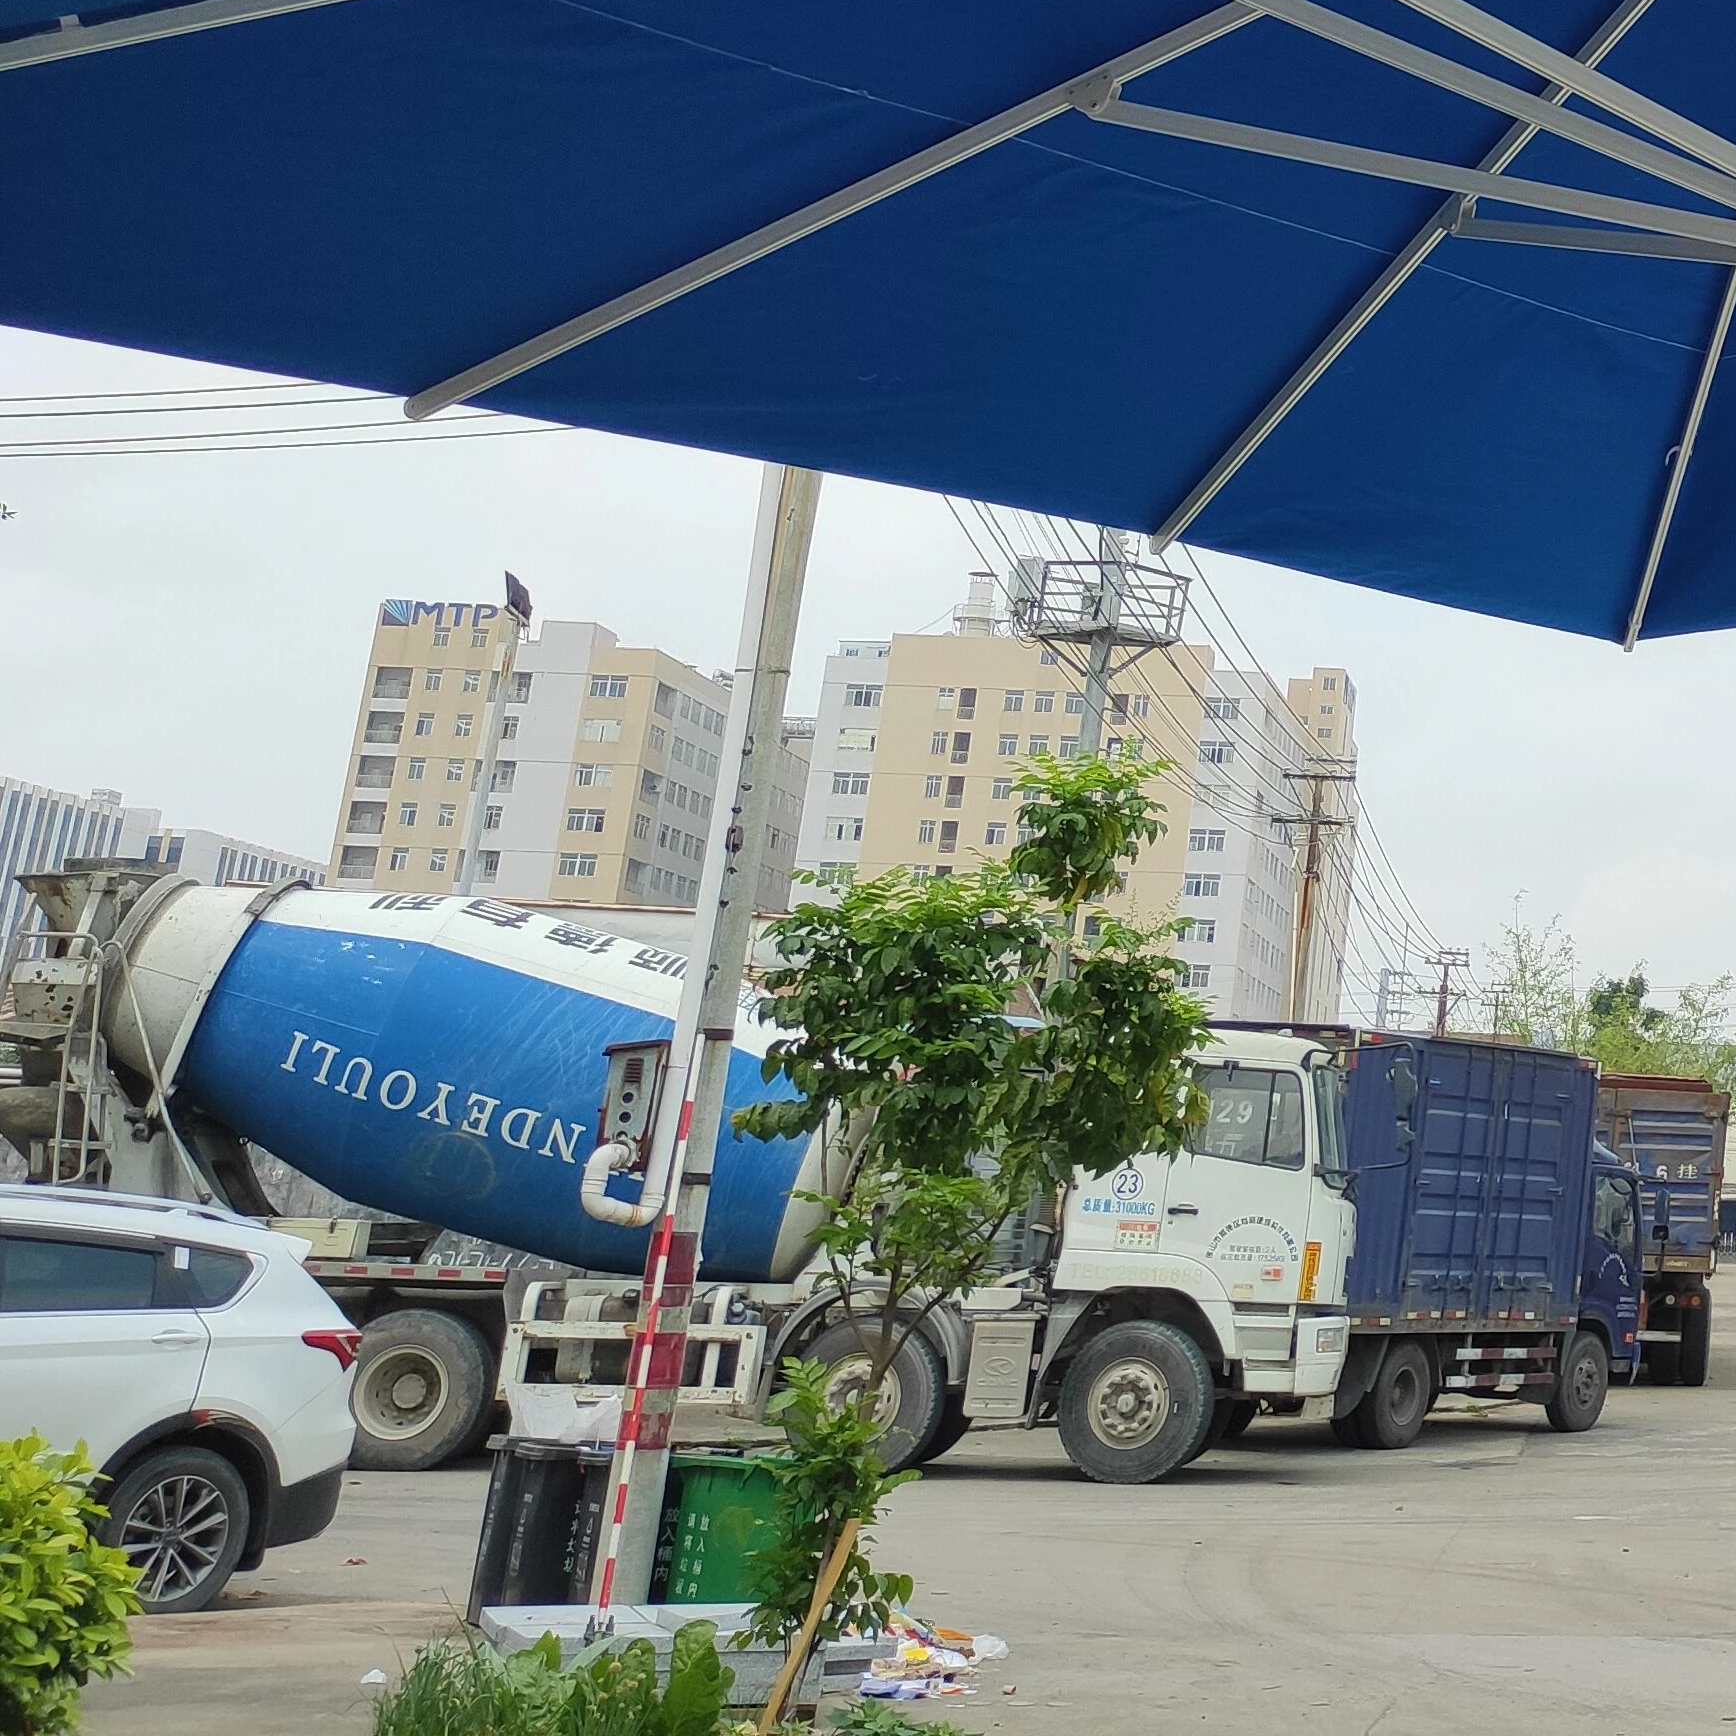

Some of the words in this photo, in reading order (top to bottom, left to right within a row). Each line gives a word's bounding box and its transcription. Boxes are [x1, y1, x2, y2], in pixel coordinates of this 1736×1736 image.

[411, 601, 499, 627] MTP
[280, 1030, 645, 1182] NDEYOULI
[1116, 1173, 1140, 1194] 23
